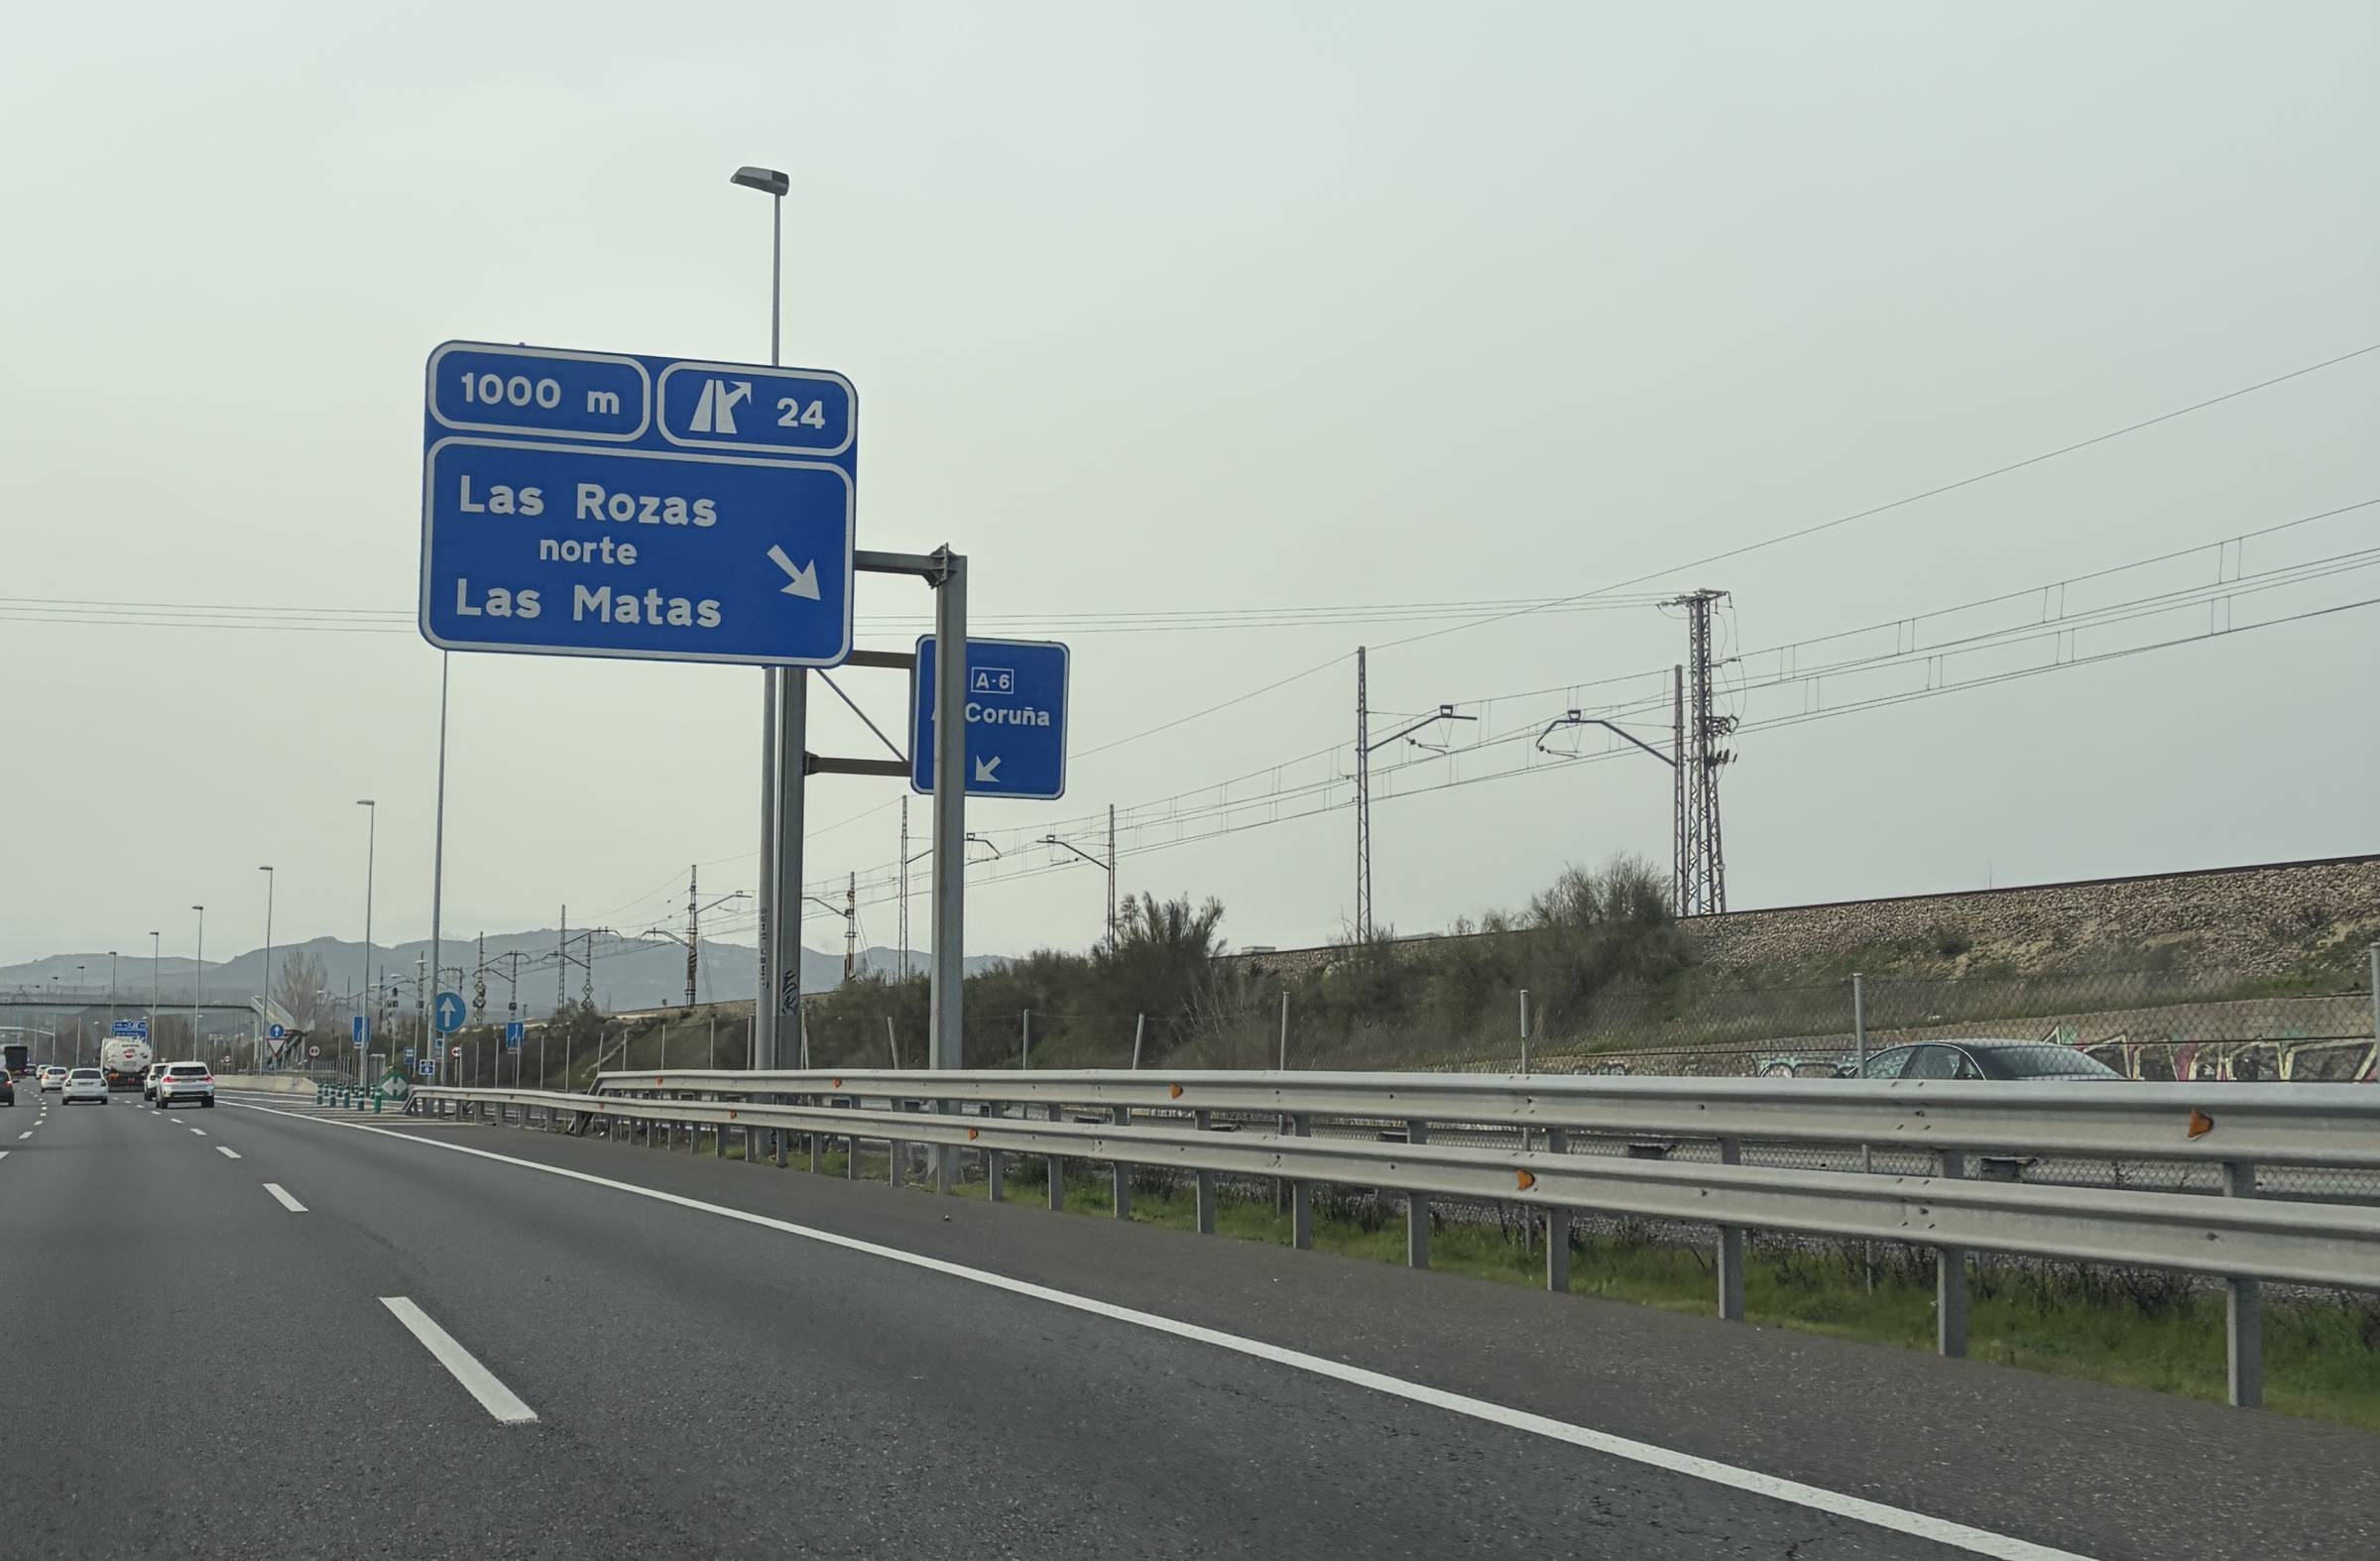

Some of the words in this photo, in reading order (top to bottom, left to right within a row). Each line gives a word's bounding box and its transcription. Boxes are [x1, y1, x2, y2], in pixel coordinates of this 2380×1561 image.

[462, 373, 561, 409] 1000
[588, 391, 620, 415] m
[776, 398, 826, 429] 24
[460, 475, 544, 516] Las
[576, 483, 718, 527] Rozas
[539, 537, 638, 565] norte
[456, 578, 541, 619] Las
[573, 584, 722, 628] Matas
[965, 702, 1050, 726] Coruña
